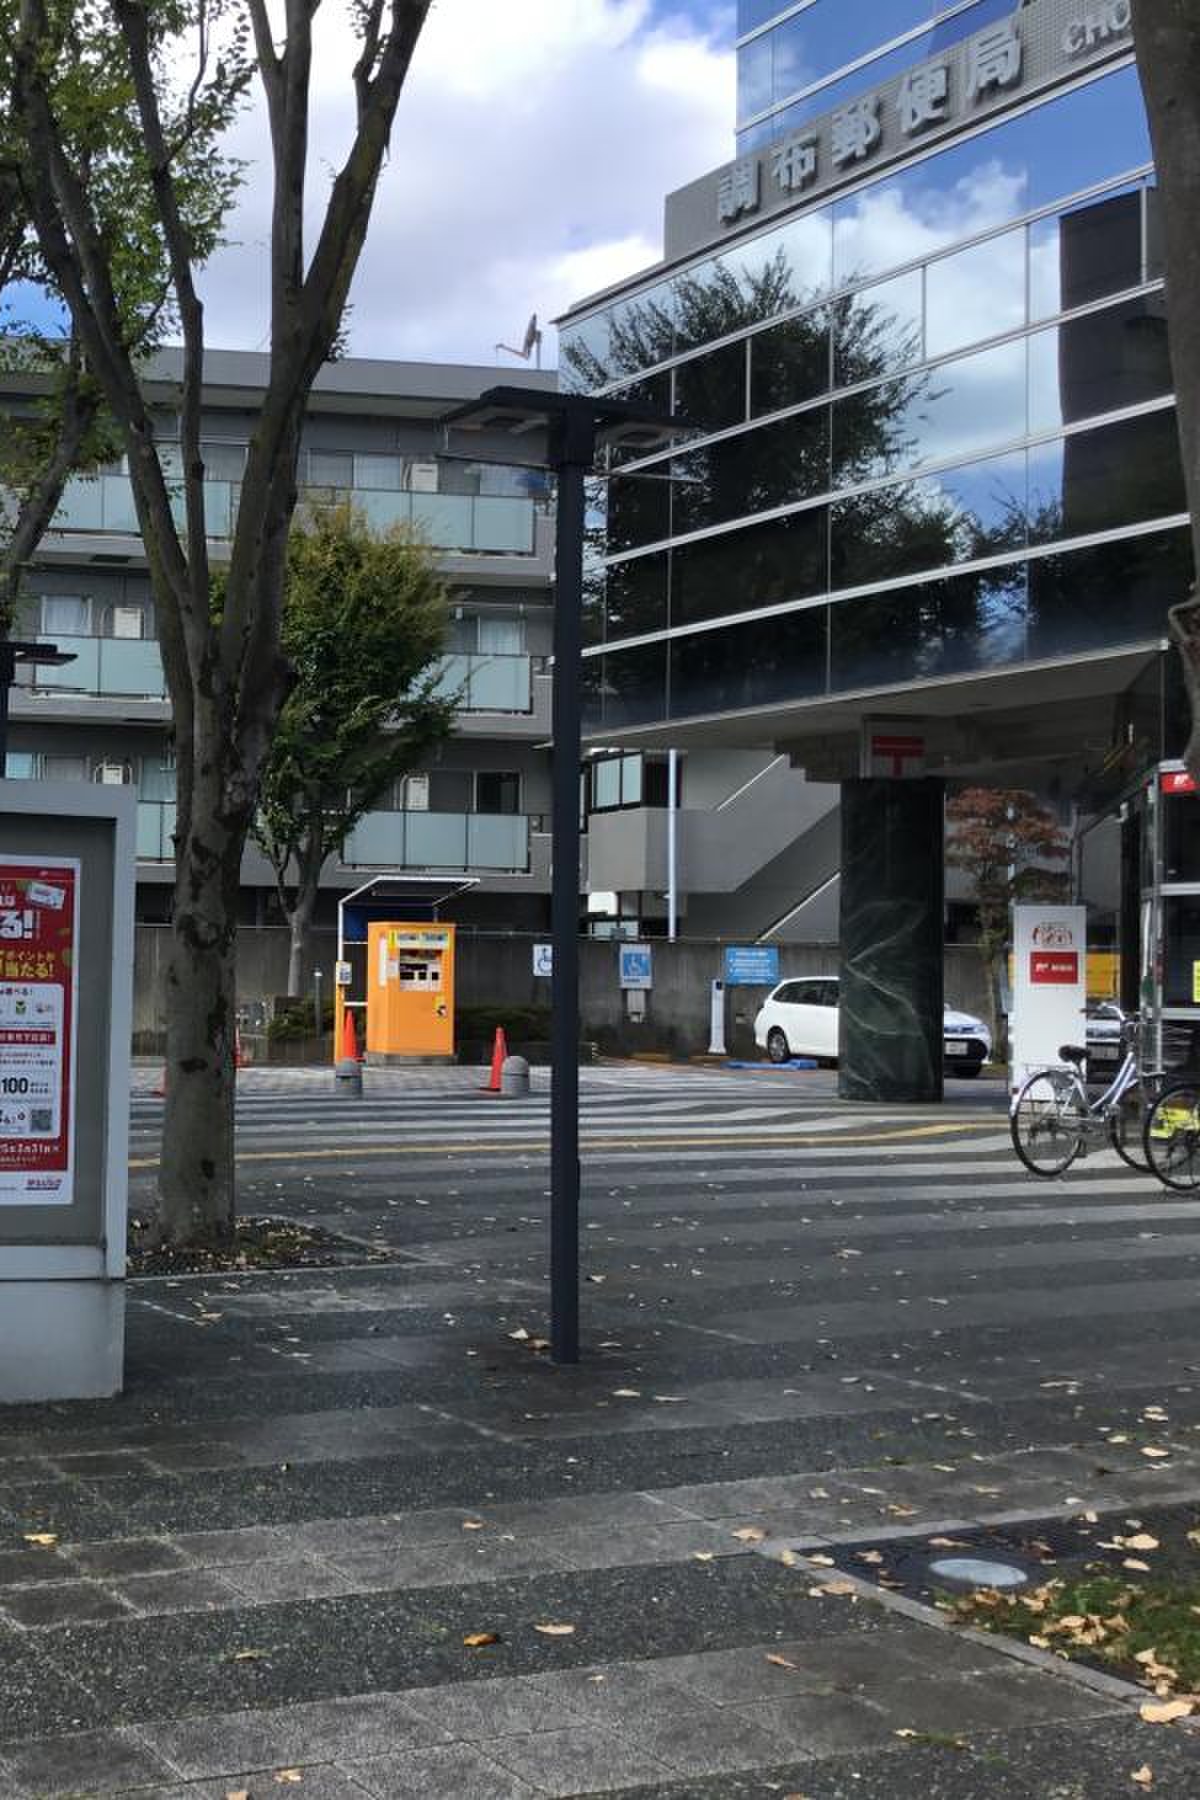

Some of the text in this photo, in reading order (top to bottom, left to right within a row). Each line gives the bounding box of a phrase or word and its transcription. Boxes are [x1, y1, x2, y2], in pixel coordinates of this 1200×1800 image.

[717, 28, 1023, 222] 調布郵便局
[1, 1077, 29, 1094] 100
